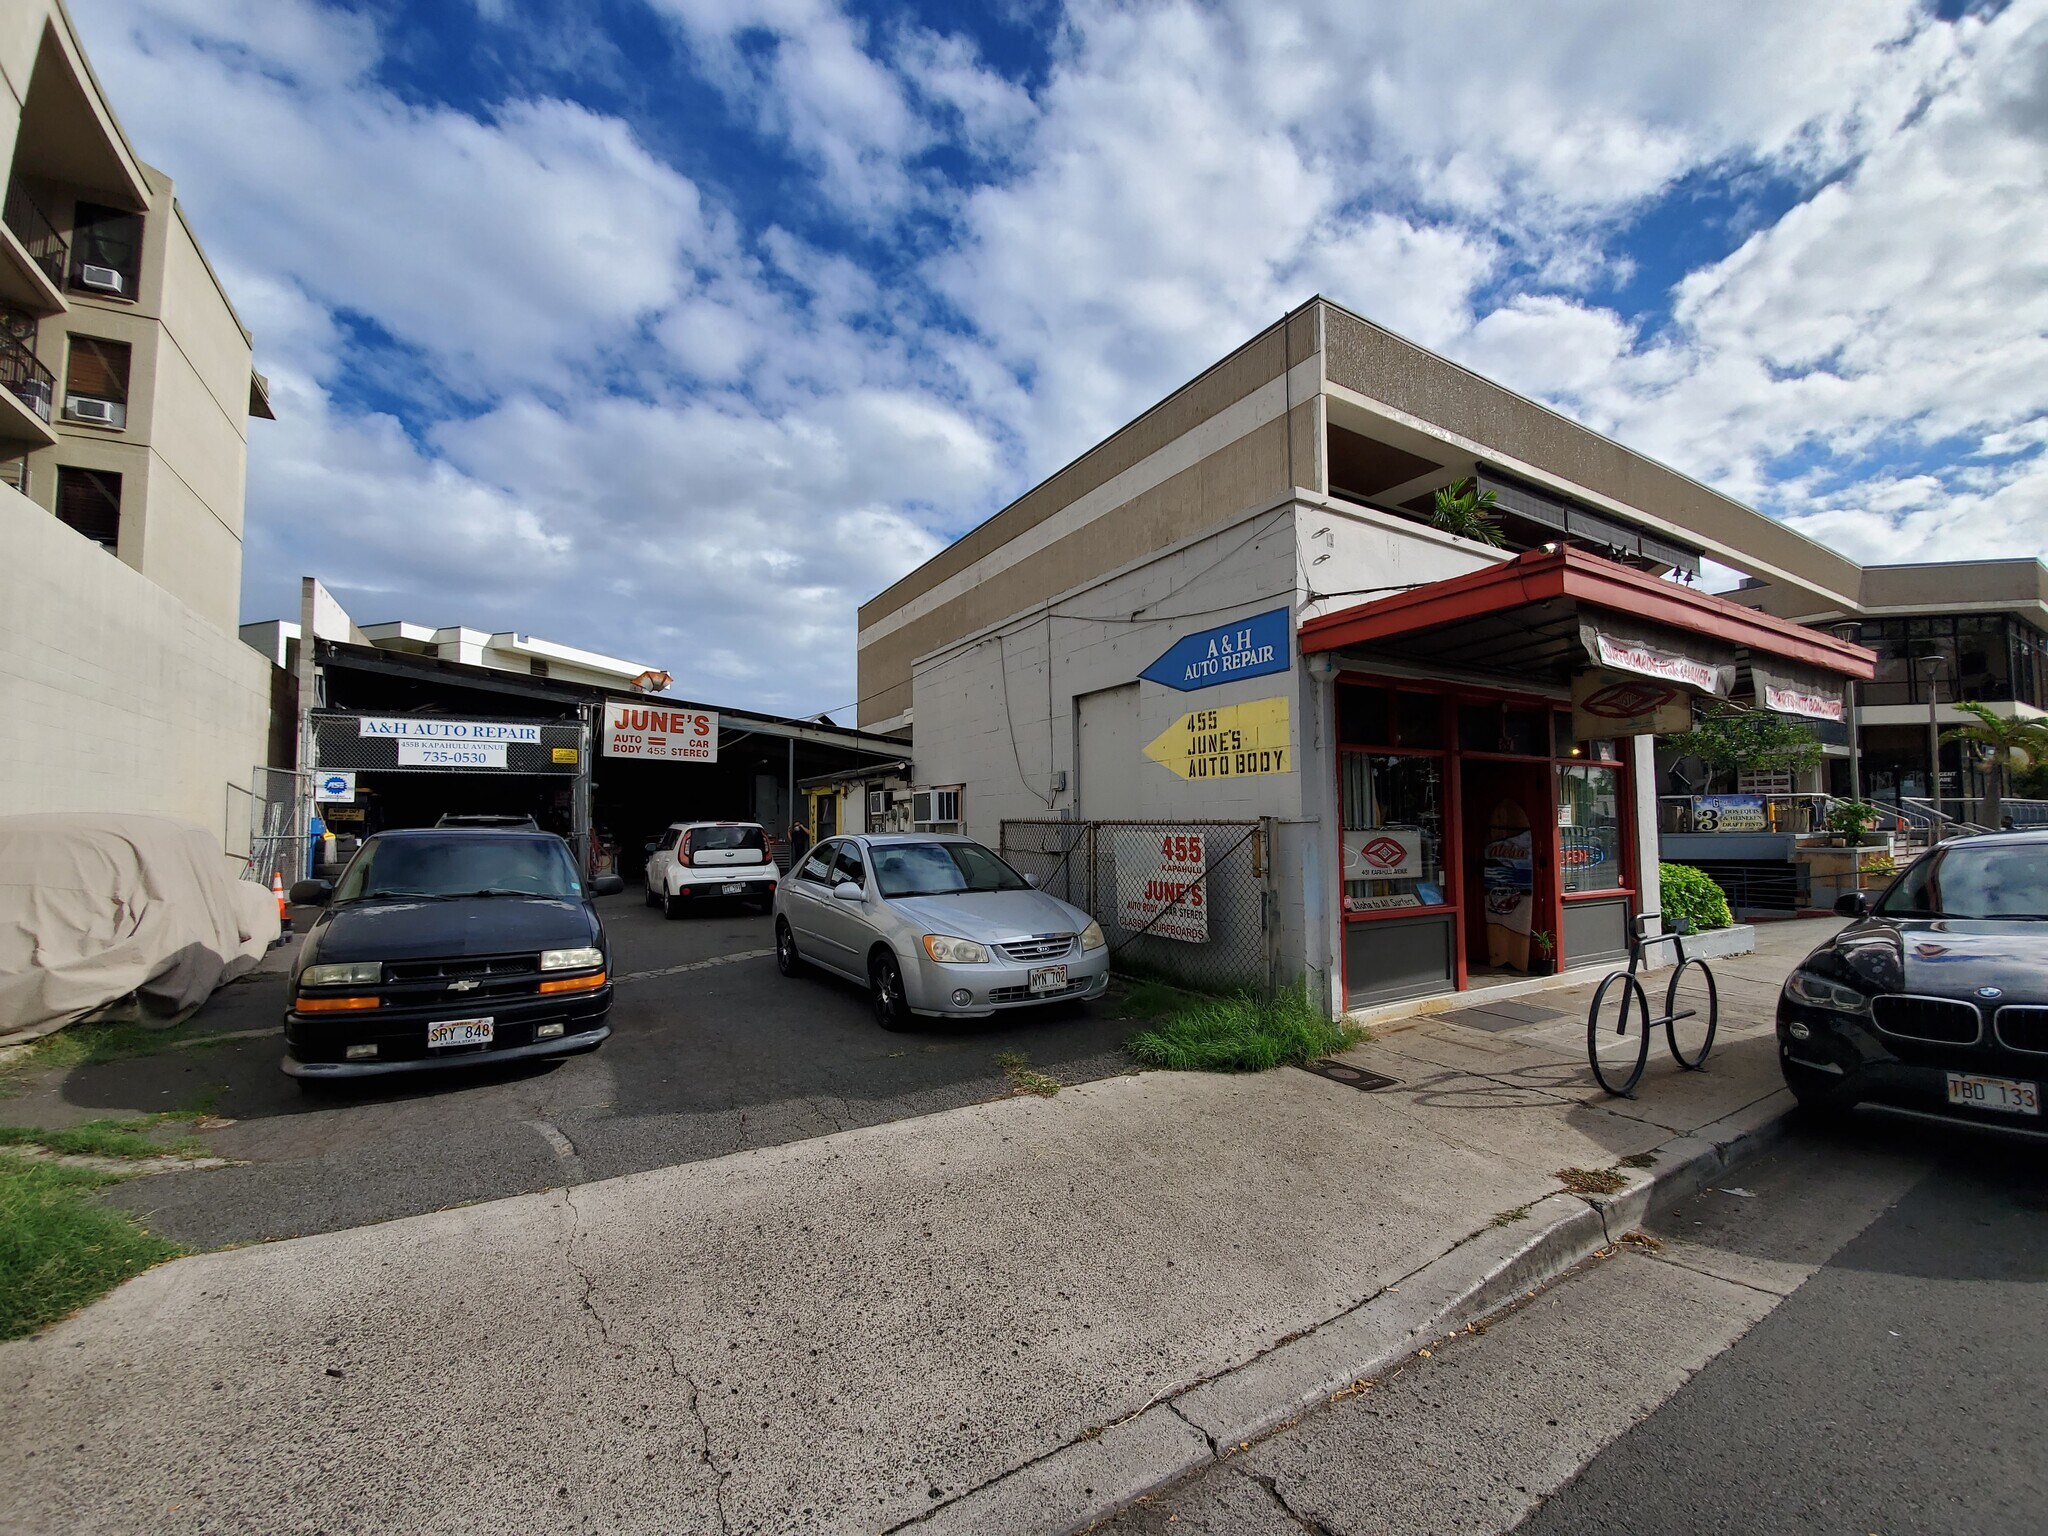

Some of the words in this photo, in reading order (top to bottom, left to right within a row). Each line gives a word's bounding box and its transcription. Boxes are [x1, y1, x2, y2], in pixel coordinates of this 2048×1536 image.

[1206, 638, 1218, 659] A
[1221, 634, 1232, 654] &
[1236, 628, 1252, 650] H
[1184, 656, 1219, 681] AUTO
[1222, 645, 1274, 672] REPAIR
[365, 720, 407, 735] A&H
[414, 724, 467, 737] AUTO
[473, 726, 536, 740] REPAIR
[614, 708, 710, 737] JUNE'S
[1187, 710, 1218, 733] 455
[422, 742, 470, 750] KAPAHULU
[471, 743, 505, 751] AVENUE
[614, 734, 642, 744] AUTO
[689, 739, 709, 748] CAR
[1187, 729, 1242, 756] JUNE'S
[423, 751, 487, 764] 735-0530
[613, 744, 642, 754] BODY
[647, 747, 666, 755] 455
[671, 748, 709, 758] STEREO
[1188, 755, 1229, 778] AUTO
[1236, 750, 1283, 774] BODY
[1162, 836, 1202, 863] 455
[1161, 864, 1202, 874] KAPAHULU
[1144, 880, 1203, 907] JUNE'S
[1127, 901, 1141, 911] AUTO
[1142, 902, 1158, 913] BODY
[1353, 900, 1373, 910] Aloha
[1373, 899, 1381, 908] to
[1380, 899, 1390, 908] All
[1390, 898, 1416, 907] Surfers
[1119, 916, 1149, 930] CLASSIC
[1151, 921, 1204, 940] SURFBOARDS
[1032, 973, 1047, 987] NYN
[1051, 970, 1065, 983] 702
[431, 1027, 456, 1042] SRY
[465, 1023, 490, 1039] 848
[1949, 1079, 1985, 1100] TBD
[2000, 1086, 2035, 1108] 133
